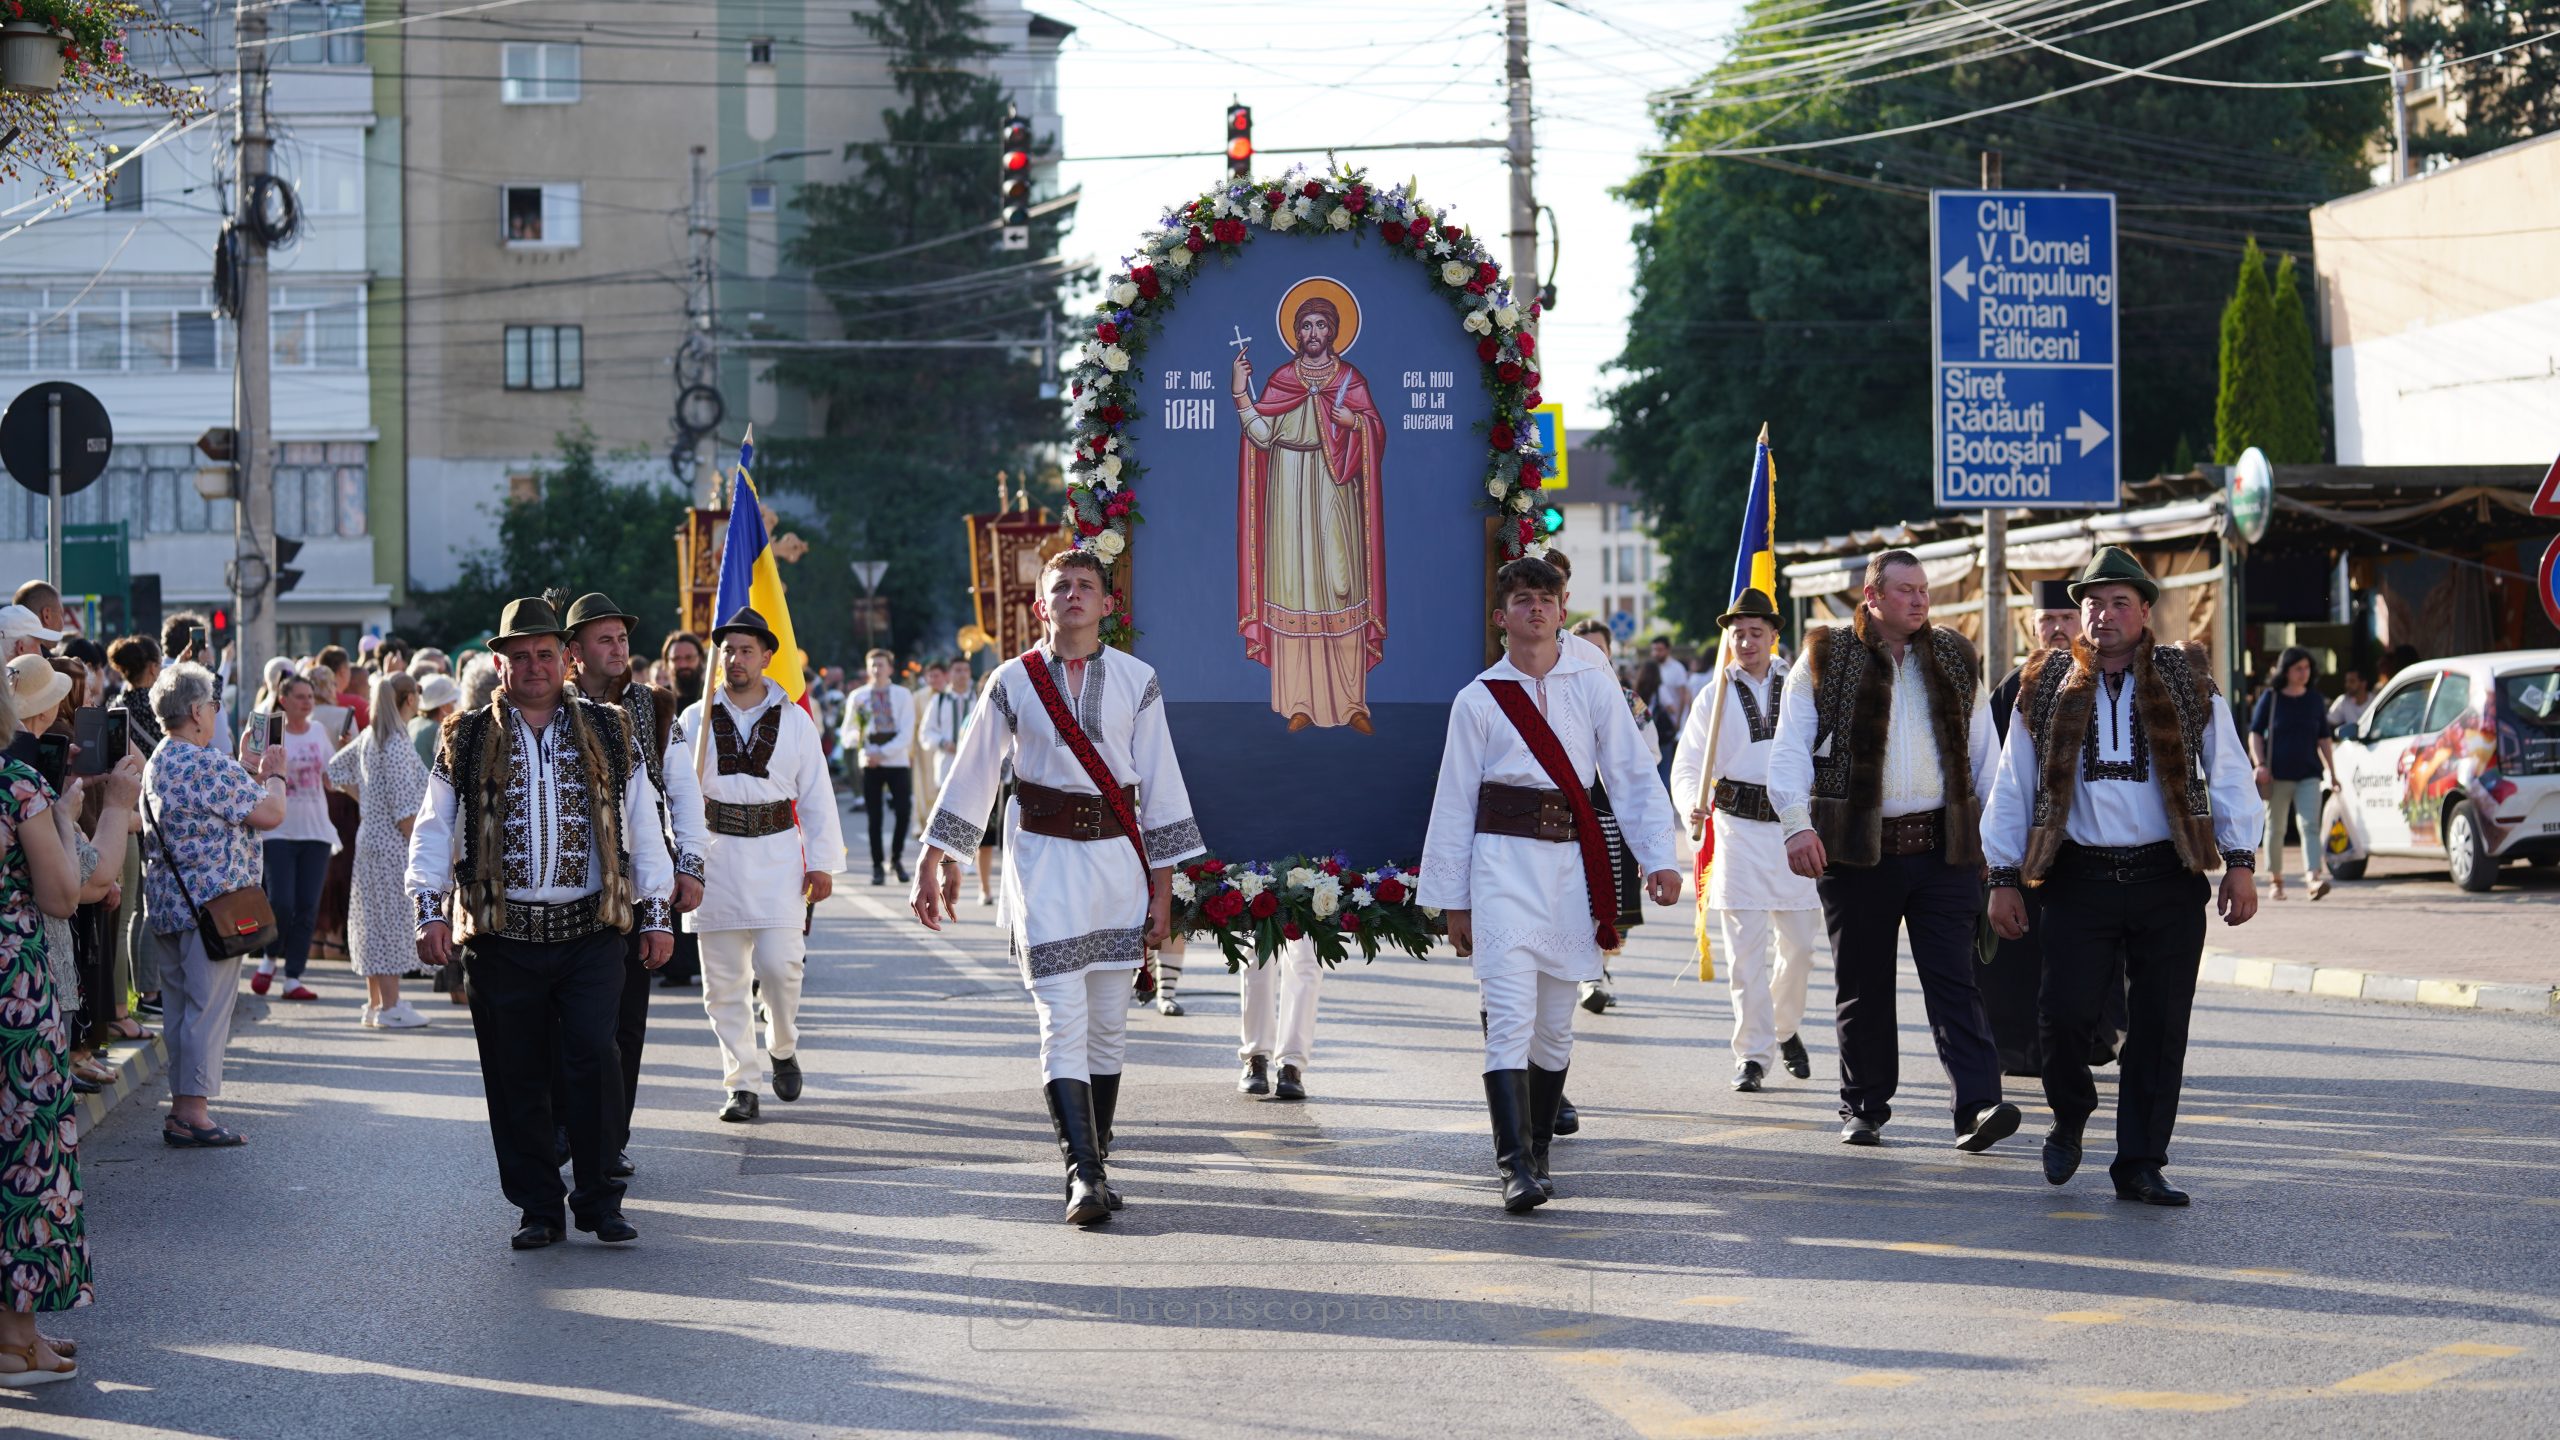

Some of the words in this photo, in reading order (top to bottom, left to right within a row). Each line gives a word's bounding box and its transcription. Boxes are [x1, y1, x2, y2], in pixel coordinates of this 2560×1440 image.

[1977, 199, 2026, 236] Cluj
[1977, 231, 2003, 263] V.
[2010, 233, 2090, 265] Dornei
[1978, 263, 2112, 306] Cîmpulung
[1979, 296, 2067, 328] Roman
[1979, 327, 2080, 360] Fălticeni
[1165, 370, 1185, 390] SF.
[1190, 370, 1215, 390] MC.
[1403, 371, 1426, 388] CEL
[1945, 368, 2006, 400] Siret
[1411, 392, 1427, 409] DE
[1430, 392, 1445, 409] LA
[1403, 414, 1453, 430] SUCEAVA
[1947, 464, 2051, 497] Dorohoi
